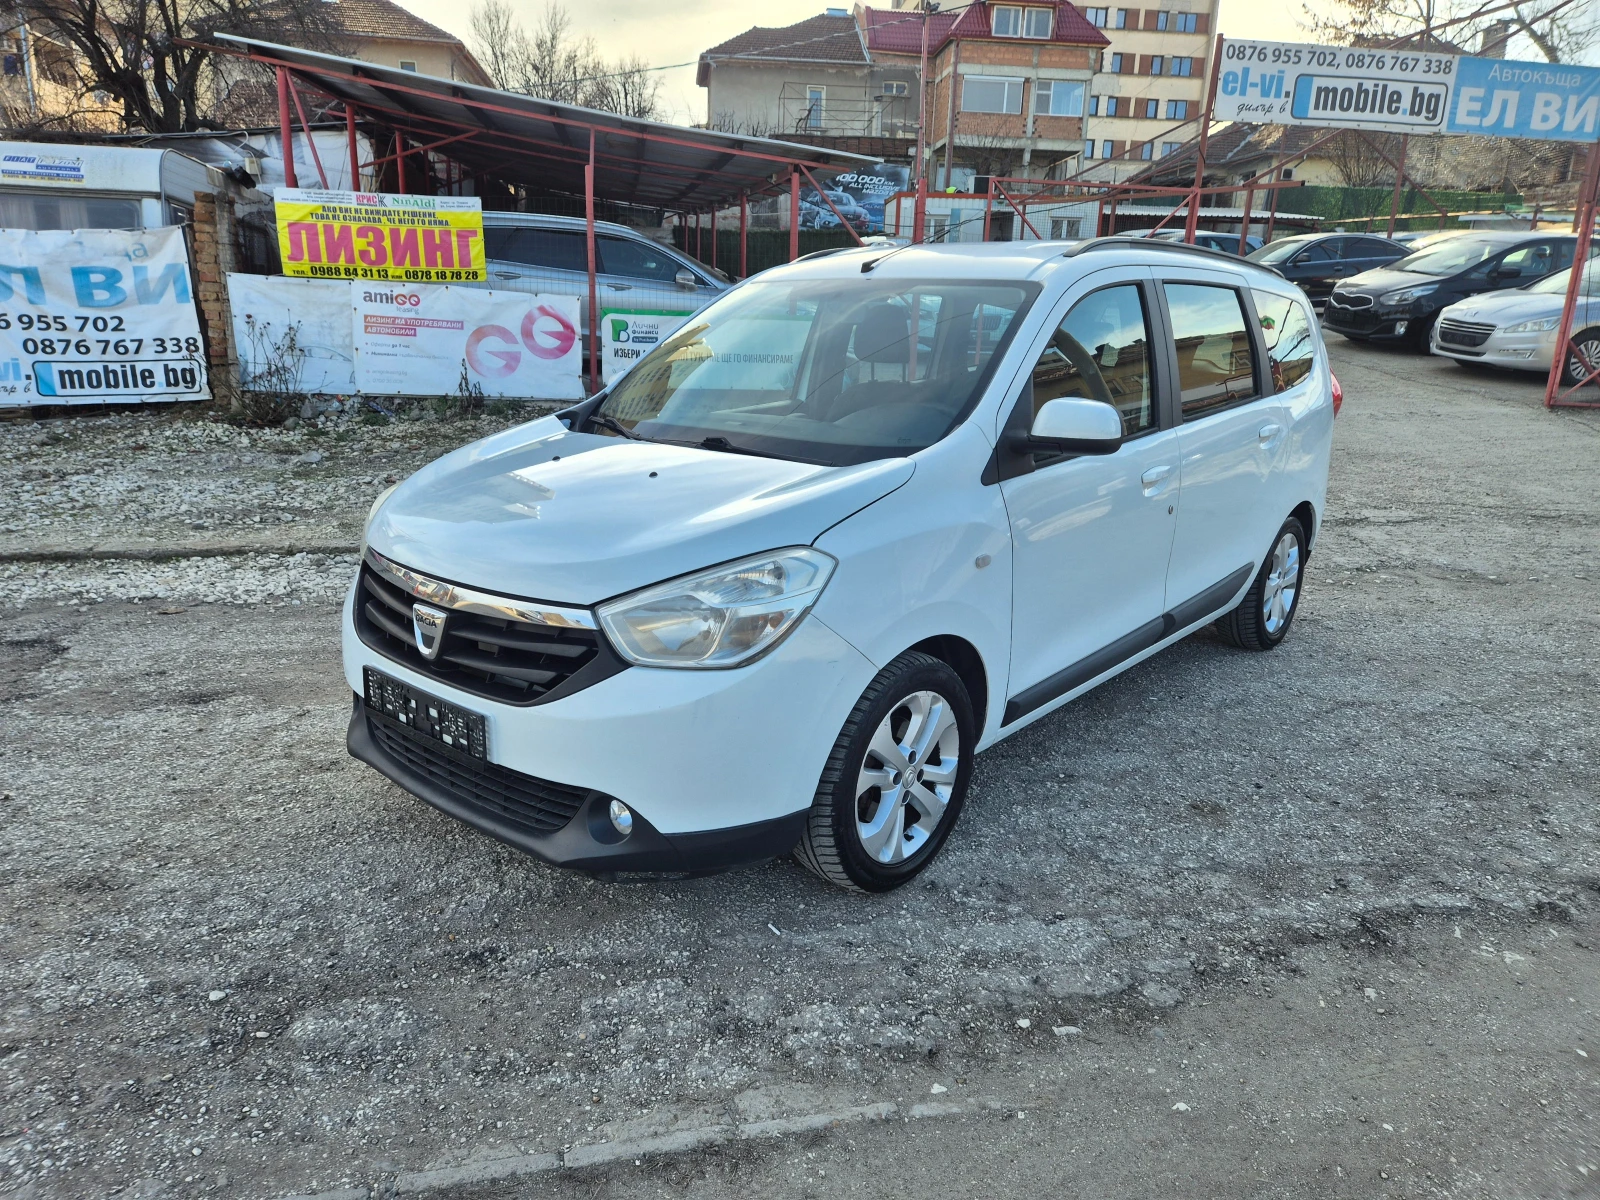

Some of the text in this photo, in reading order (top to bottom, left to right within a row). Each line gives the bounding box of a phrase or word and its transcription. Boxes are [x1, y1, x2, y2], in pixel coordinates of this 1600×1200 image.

[1226, 44, 1453, 75] 0876 955 702, 0876 767 338
[1488, 64, 1582, 88] Автокъща
[1313, 82, 1442, 121] mobile.bg
[1236, 101, 1275, 116] дилър
[1455, 86, 1599, 134] ЕЛ ВИ
[3, 155, 36, 163] FIAT
[858, 175, 885, 184] 000
[863, 184, 901, 192] INCLUSIVE
[356, 194, 378, 204] КРИС
[322, 206, 337, 214] АКО
[339, 206, 353, 215] ВИЕ
[354, 208, 363, 216] НЕ
[364, 208, 400, 218] ВИЖДАТЕ
[310, 213, 331, 221] ТОВА
[342, 215, 382, 224] ОЗНАЧАВА
[387, 216, 397, 225] ЧЕ
[399, 218, 415, 226] НЕГО
[287, 222, 478, 269] ЛИЗИНГ
[310, 266, 340, 276] 0988
[343, 267, 358, 277] 84
[360, 268, 375, 278] 31
[376, 269, 389, 279] 13
[404, 270, 432, 280] 0878
[434, 271, 447, 280] 18
[449, 271, 463, 280] 78
[464, 271, 479, 280] 28
[70, 262, 191, 308] ВИ
[396, 305, 419, 315] leasing
[17, 313, 68, 332] 955
[74, 316, 126, 332] 702
[366, 316, 394, 324] ЛИЗИНГ
[406, 319, 462, 329] УПОТРЕБЯВАНИ
[632, 321, 659, 330] Лични
[366, 326, 415, 336] АВТОМОБИЛИ
[22, 336, 200, 355] 0876 767 338
[614, 348, 641, 359] ИЗБЕРИ
[721, 353, 732, 364] ЩЕ
[733, 354, 742, 363] ГО
[742, 354, 793, 364] ФИНАНСИРАМЕ
[58, 363, 197, 390] mobile.bg
[415, 614, 437, 628] DACIA
